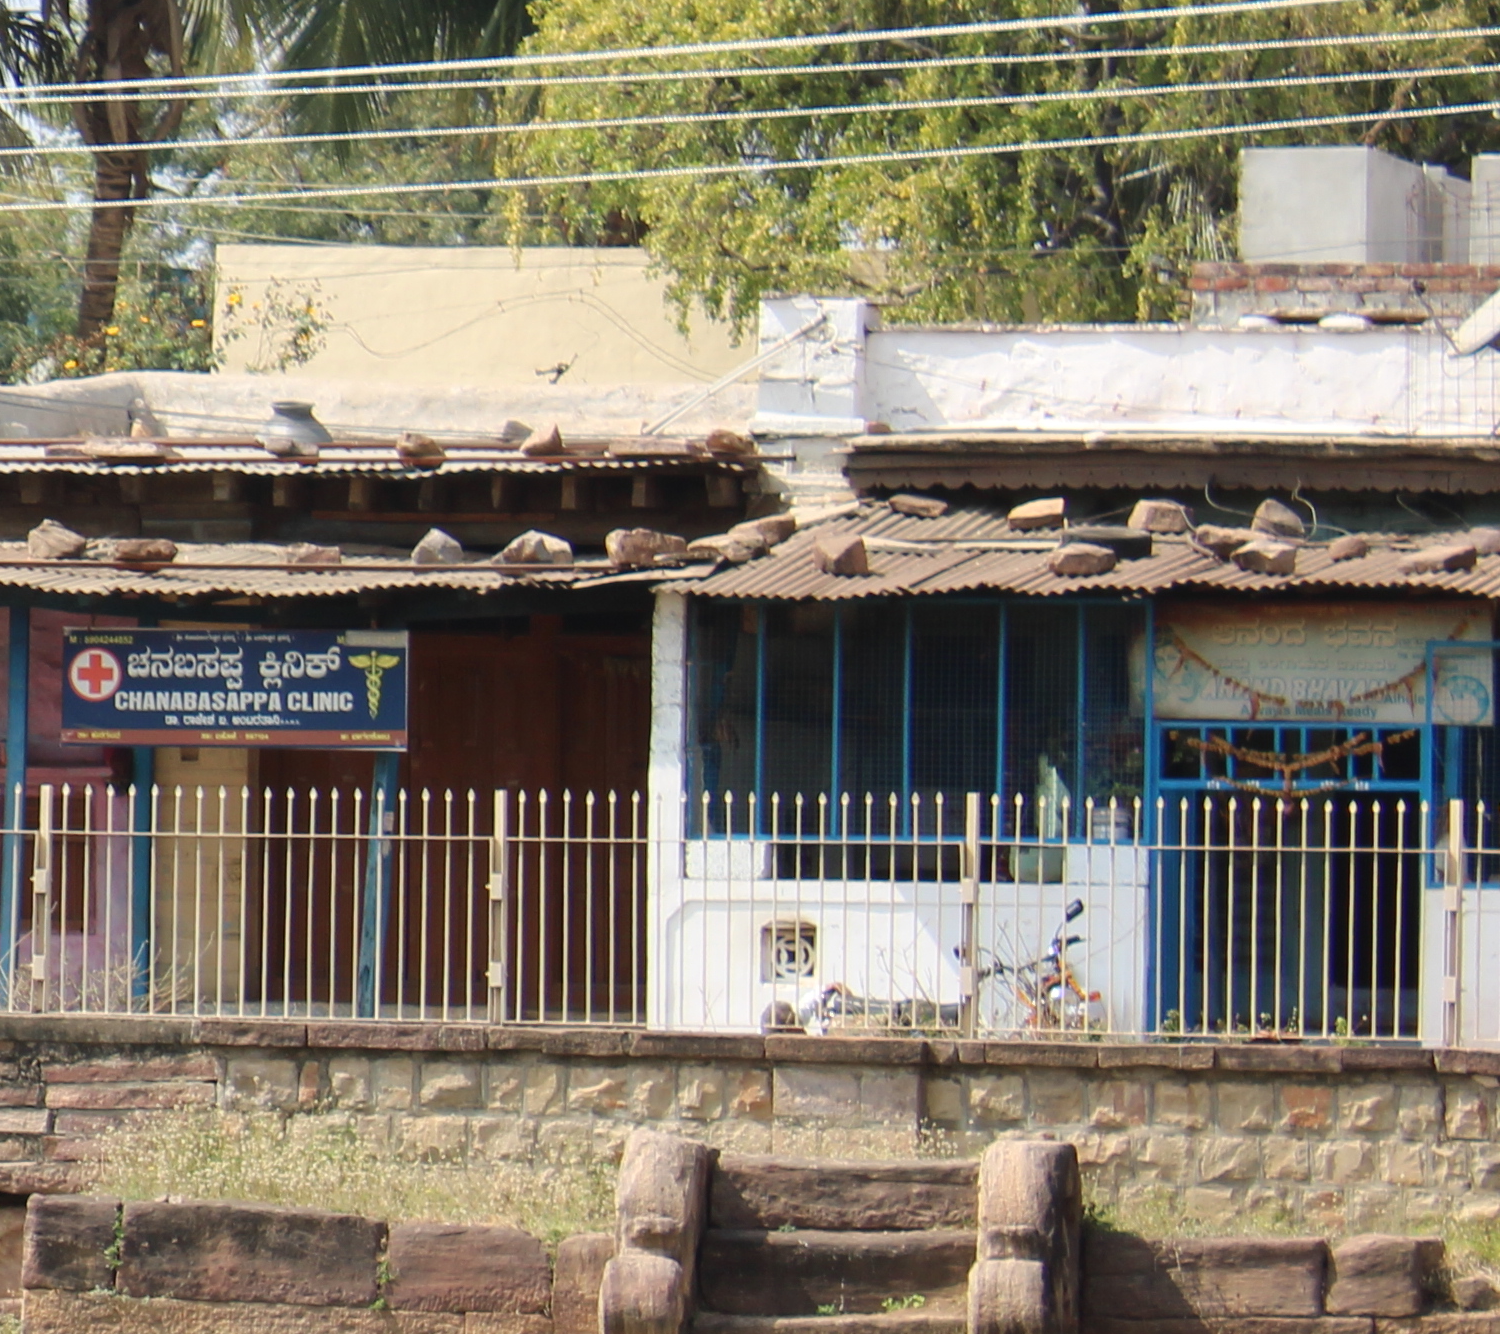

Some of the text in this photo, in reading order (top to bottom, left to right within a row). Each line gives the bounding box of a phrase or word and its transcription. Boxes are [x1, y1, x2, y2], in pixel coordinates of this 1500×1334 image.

[1323, 619, 1399, 653] ಭವನ
[127, 646, 341, 690] ಚನಬಸಪ್ಪ ಕ್ಲಿನಿಕ್
[114, 691, 354, 713] CHANABASAPPA CLINIC
[1383, 692, 1426, 705] Aihle
